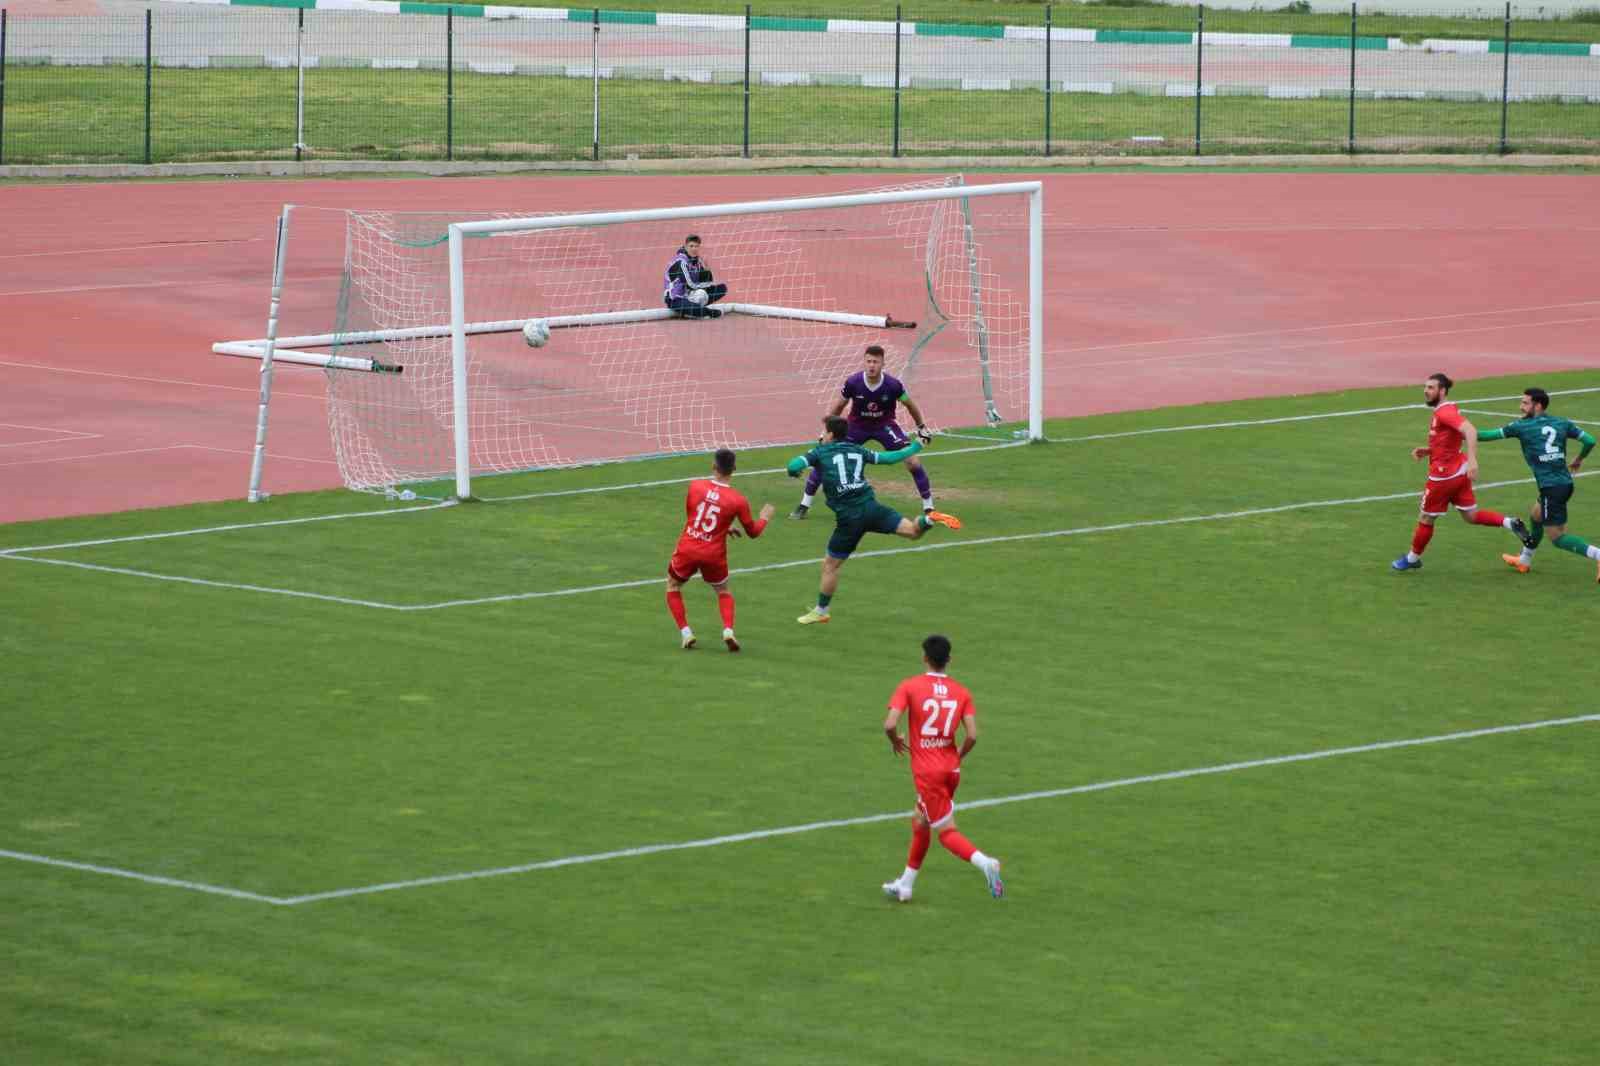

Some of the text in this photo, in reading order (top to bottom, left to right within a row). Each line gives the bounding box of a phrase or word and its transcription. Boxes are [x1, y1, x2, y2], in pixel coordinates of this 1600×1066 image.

[888, 430, 902, 443] 1
[1541, 425, 1560, 454] 2
[832, 452, 863, 485] 17
[693, 501, 721, 533] 15
[921, 698, 958, 737] 27
